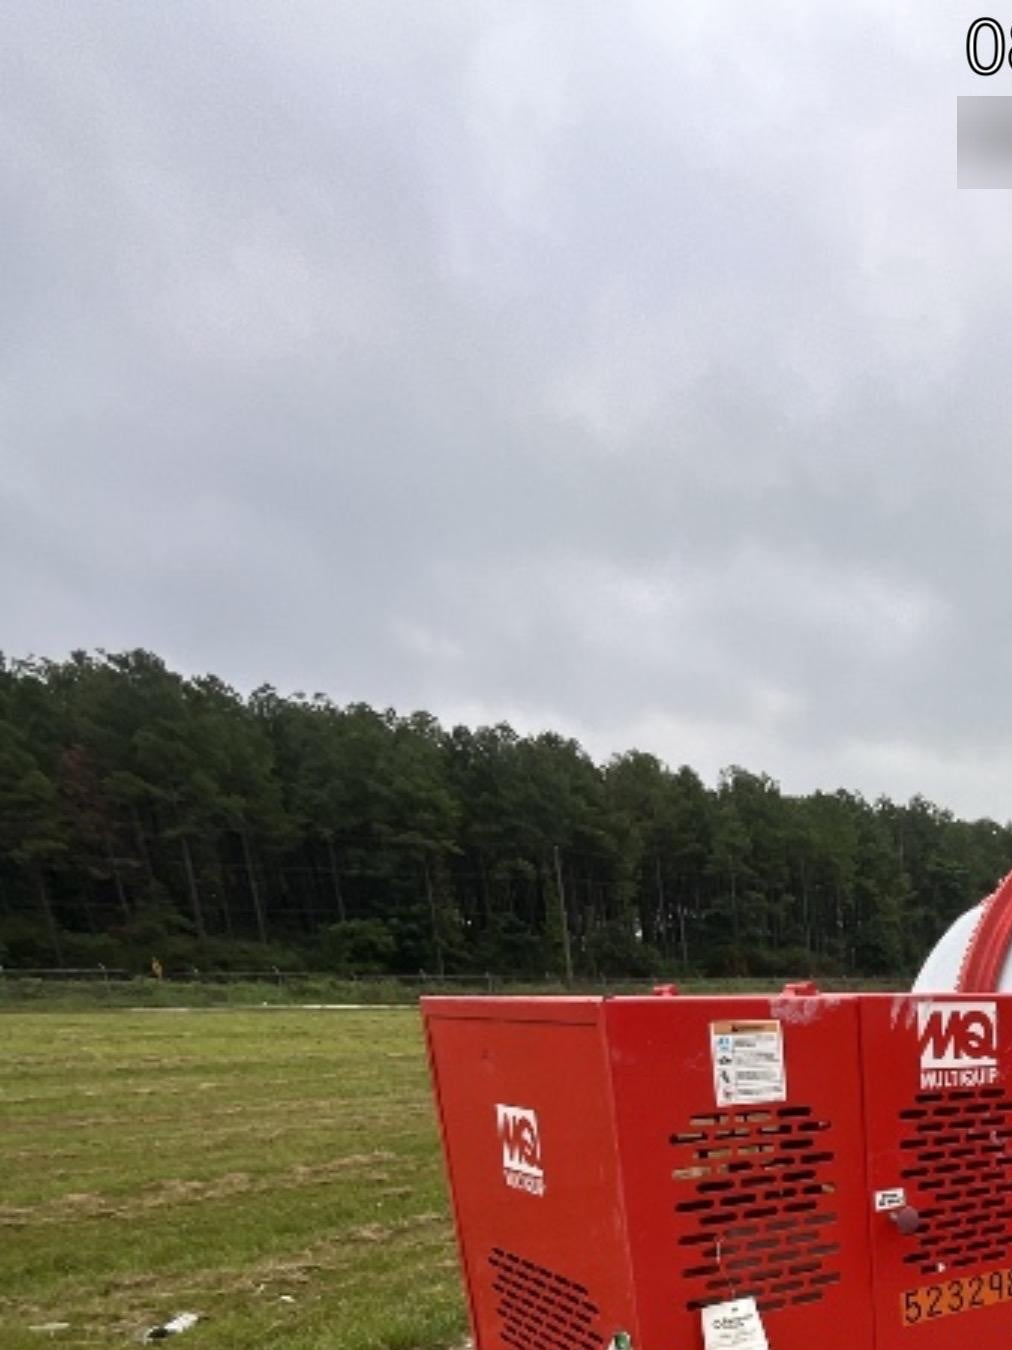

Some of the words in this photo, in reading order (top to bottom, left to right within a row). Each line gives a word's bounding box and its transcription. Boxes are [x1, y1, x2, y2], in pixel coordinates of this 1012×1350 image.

[917, 1009, 998, 1060] MQ
[919, 1067, 999, 1090] MULTIQUIP
[498, 1108, 541, 1169] MQ
